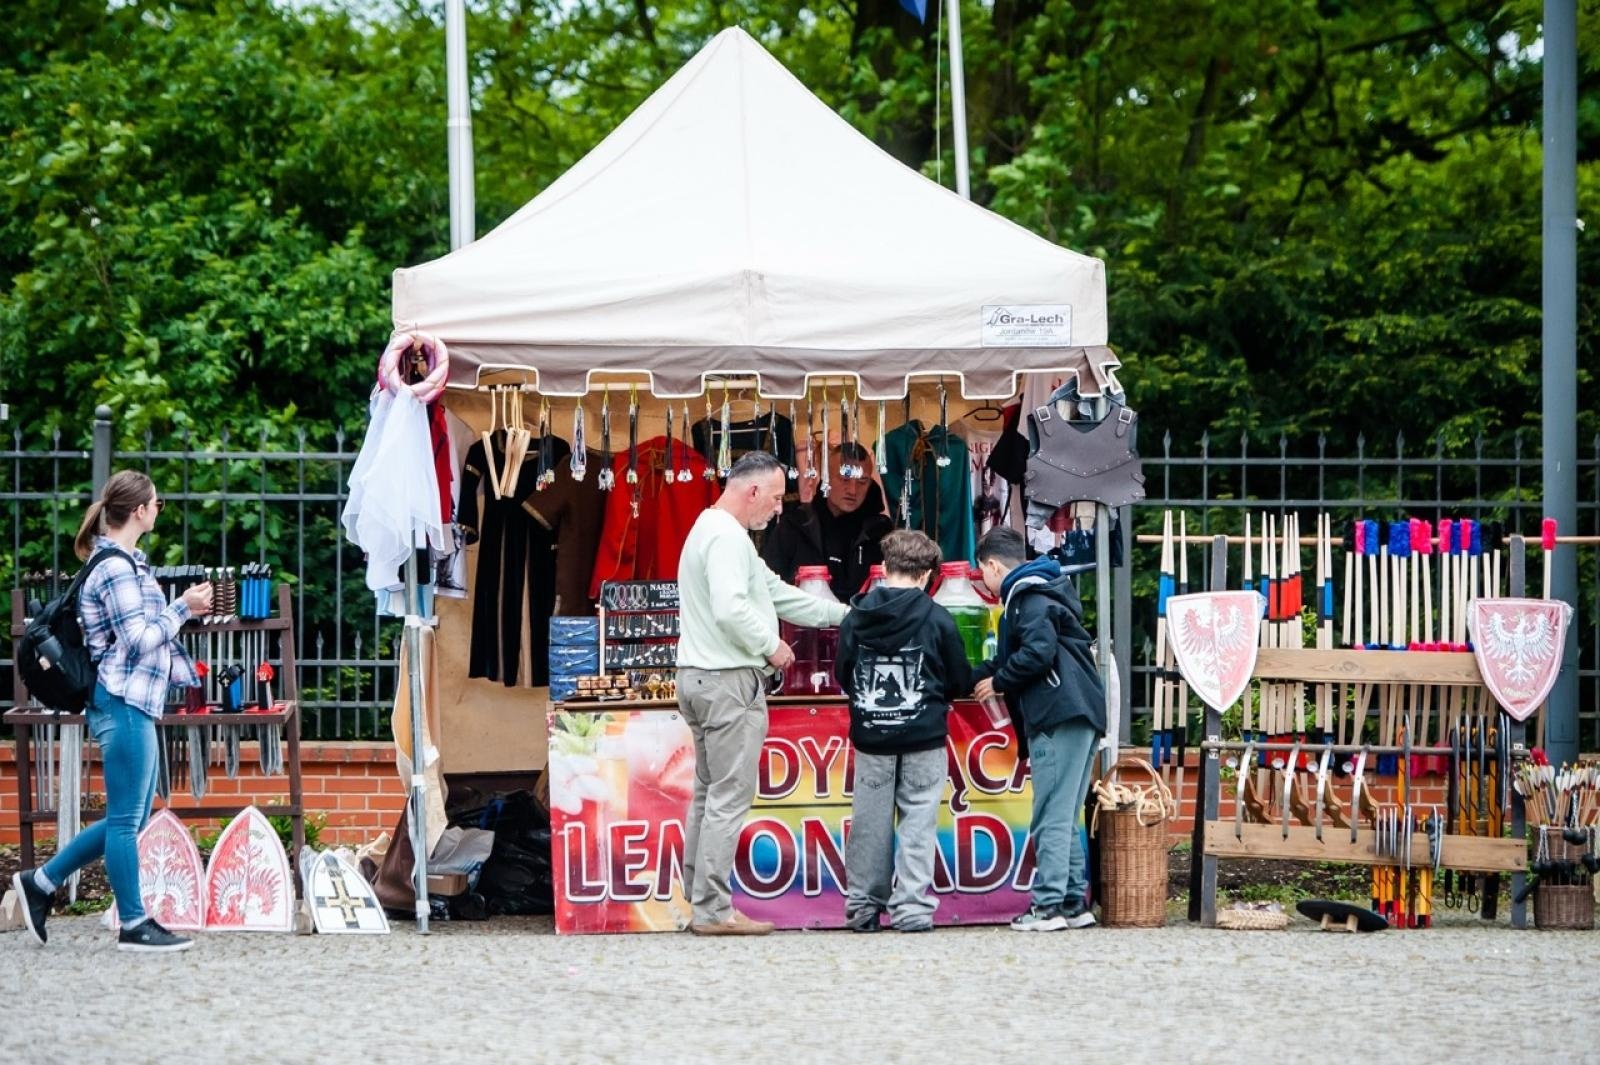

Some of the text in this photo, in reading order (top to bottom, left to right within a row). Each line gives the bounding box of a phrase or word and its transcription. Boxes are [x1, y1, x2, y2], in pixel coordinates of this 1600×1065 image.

[1000, 314, 1064, 324] Gra-Lech
[756, 732, 1031, 814] DYĄC
[565, 812, 1038, 902] LEOND
